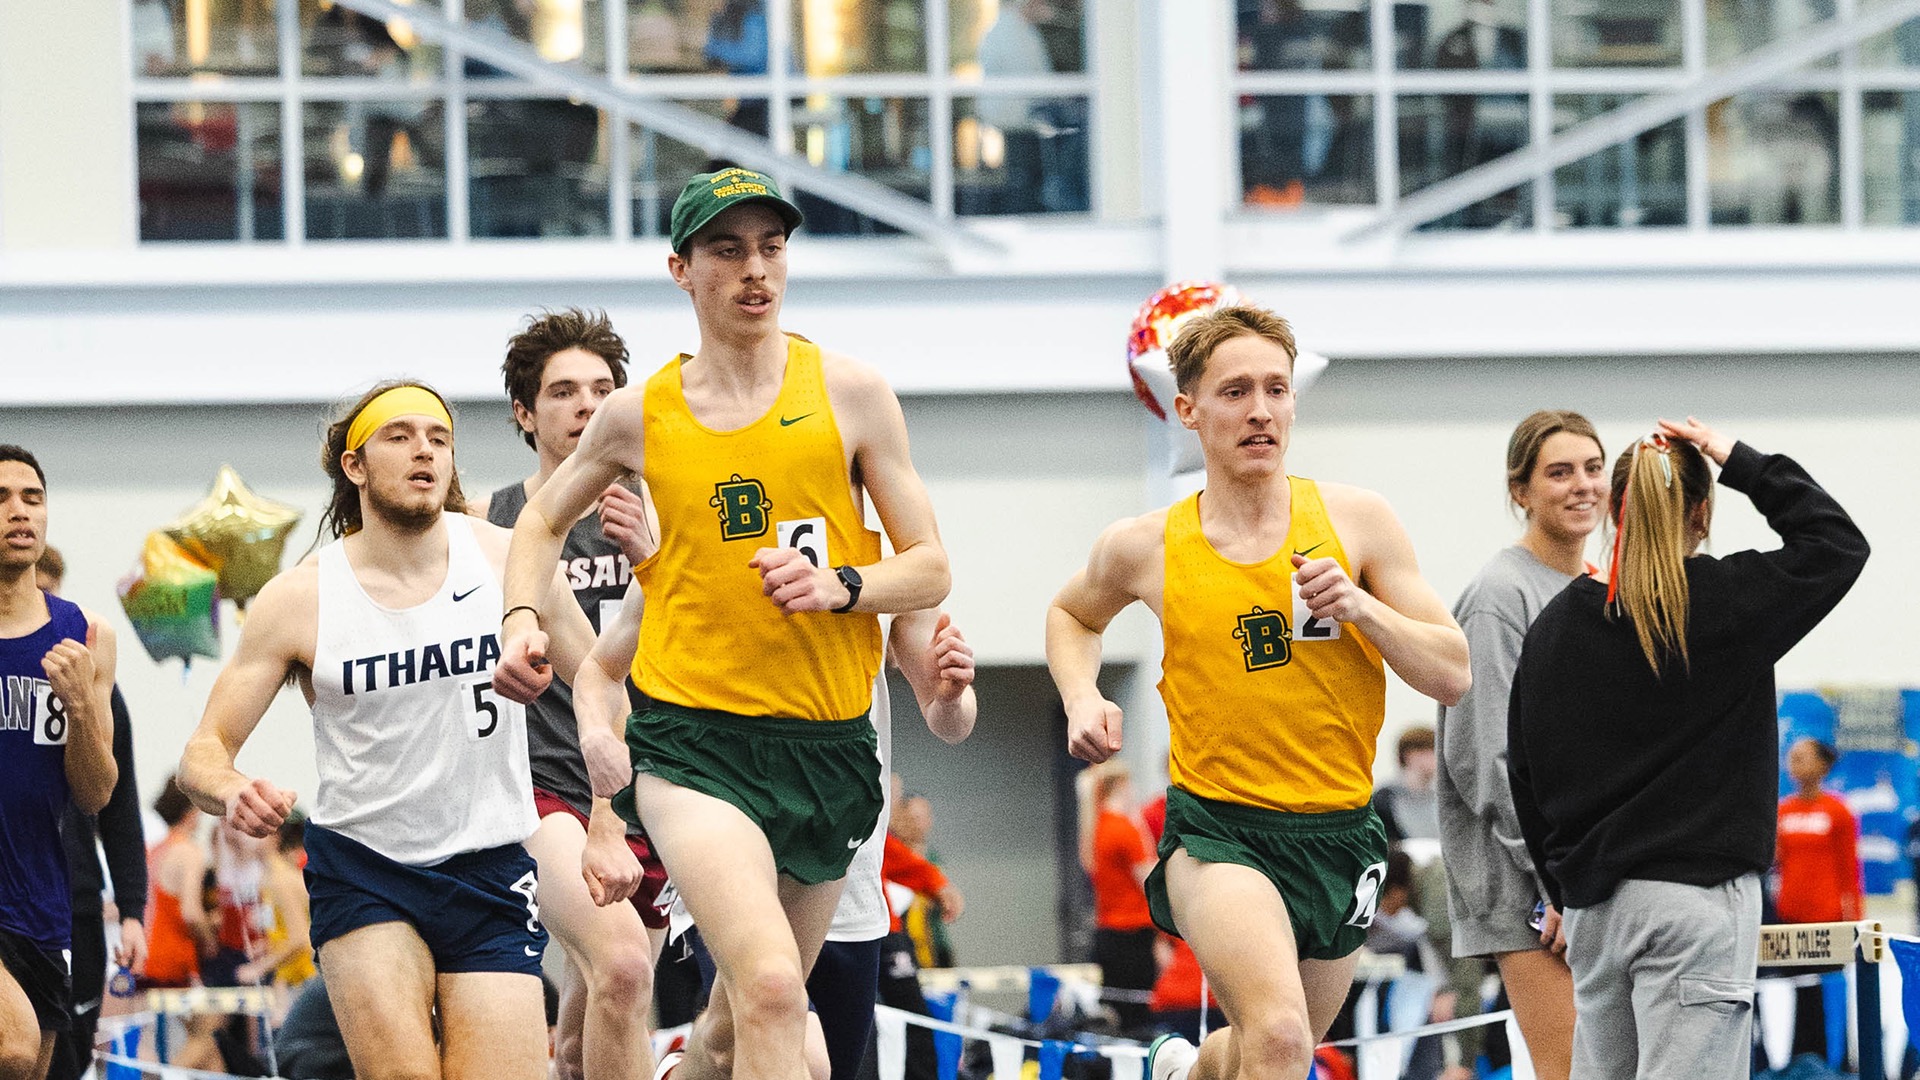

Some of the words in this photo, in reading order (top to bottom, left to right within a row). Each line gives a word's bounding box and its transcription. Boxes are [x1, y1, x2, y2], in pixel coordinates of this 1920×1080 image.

[713, 184, 735, 195] CROSS
[735, 182, 767, 192] COUNTRY
[715, 478, 769, 542] B
[343, 634, 500, 695] ITHACA
[1237, 610, 1292, 672] B
[44, 691, 66, 741] 8
[473, 681, 498, 738] 5
[1350, 866, 1383, 926] 2
[1762, 932, 1791, 960] ITHACA
[1797, 929, 1831, 958] COLLEGE
